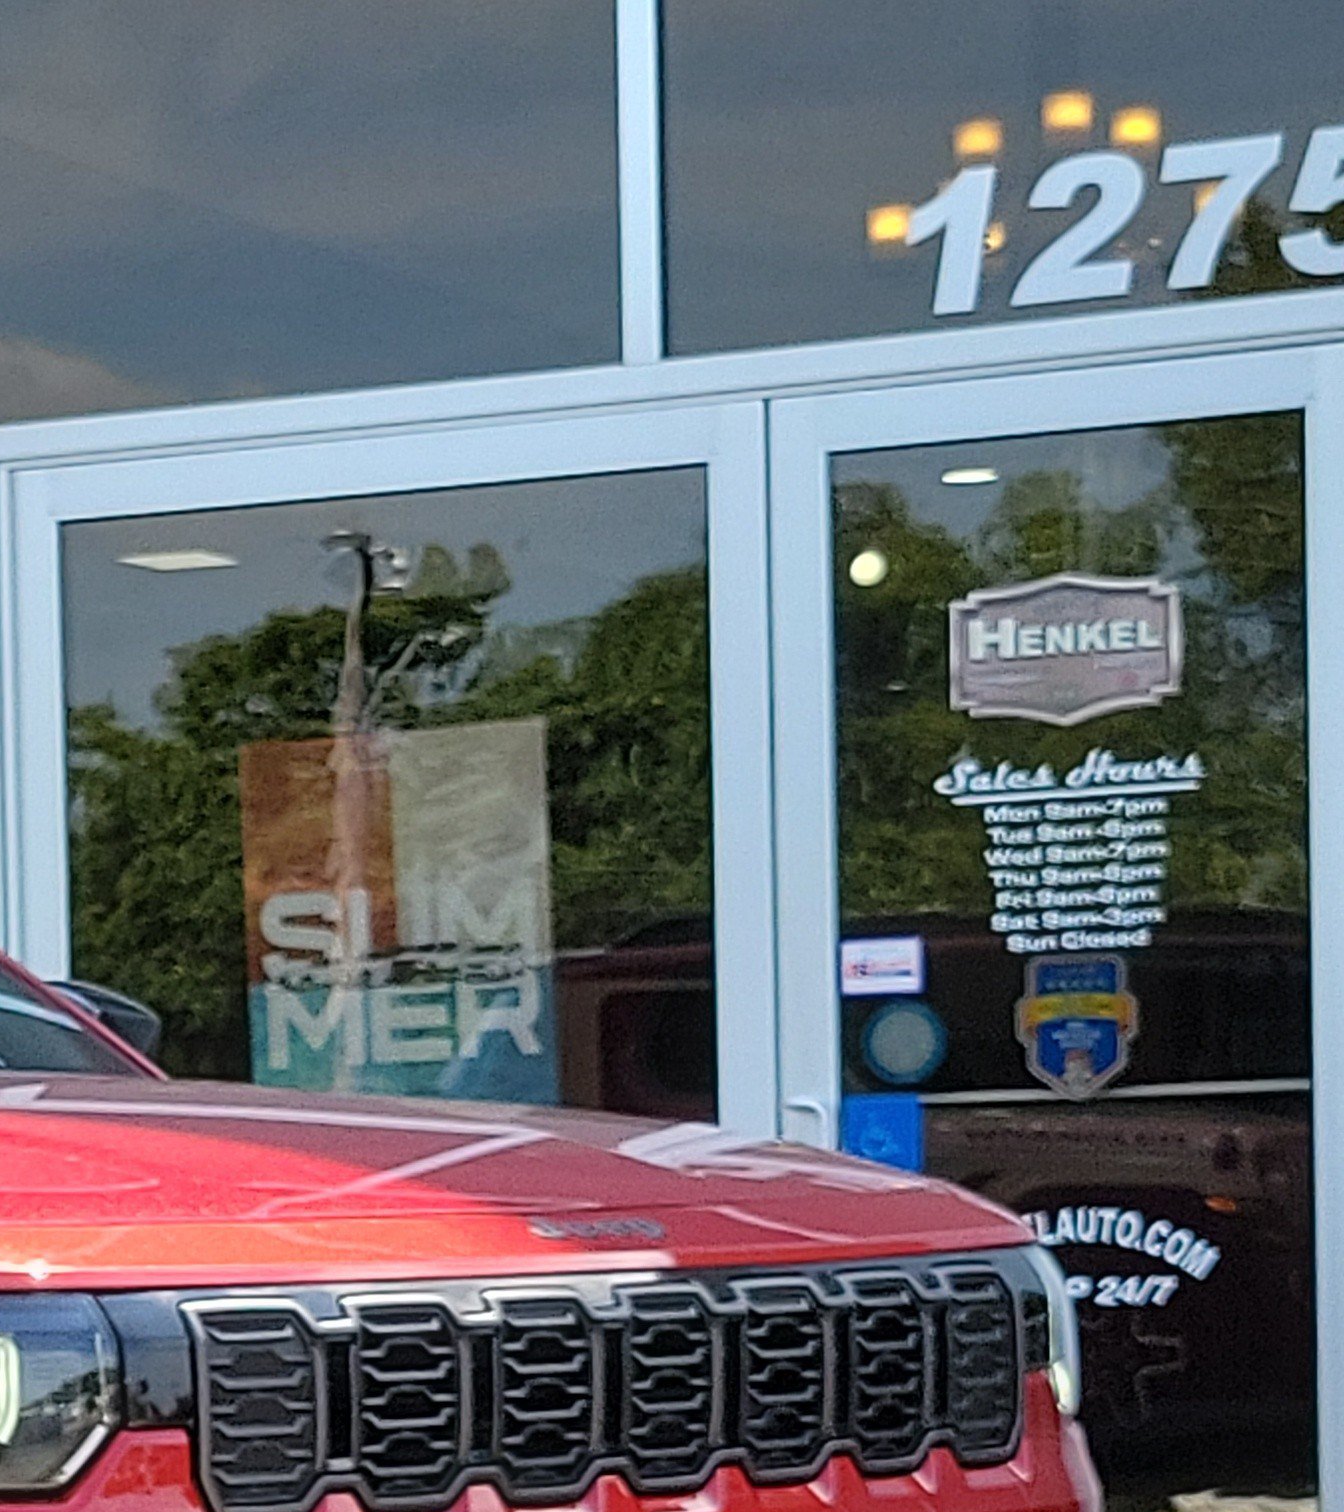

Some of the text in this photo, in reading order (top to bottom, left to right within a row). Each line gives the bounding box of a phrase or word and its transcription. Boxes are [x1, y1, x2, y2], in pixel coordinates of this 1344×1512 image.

[905, 125, 1344, 316] 1275
[968, 617, 1161, 662] HENKEL
[933, 746, 1208, 795] Sales Hours
[983, 805, 1042, 823] Mon
[983, 847, 1043, 866] Wed
[988, 869, 1039, 887] Thu
[990, 911, 1039, 932] Sat
[1006, 927, 1152, 952] Sun Closed
[265, 968, 544, 1071] MER
[1093, 1273, 1180, 1307] 24/7
